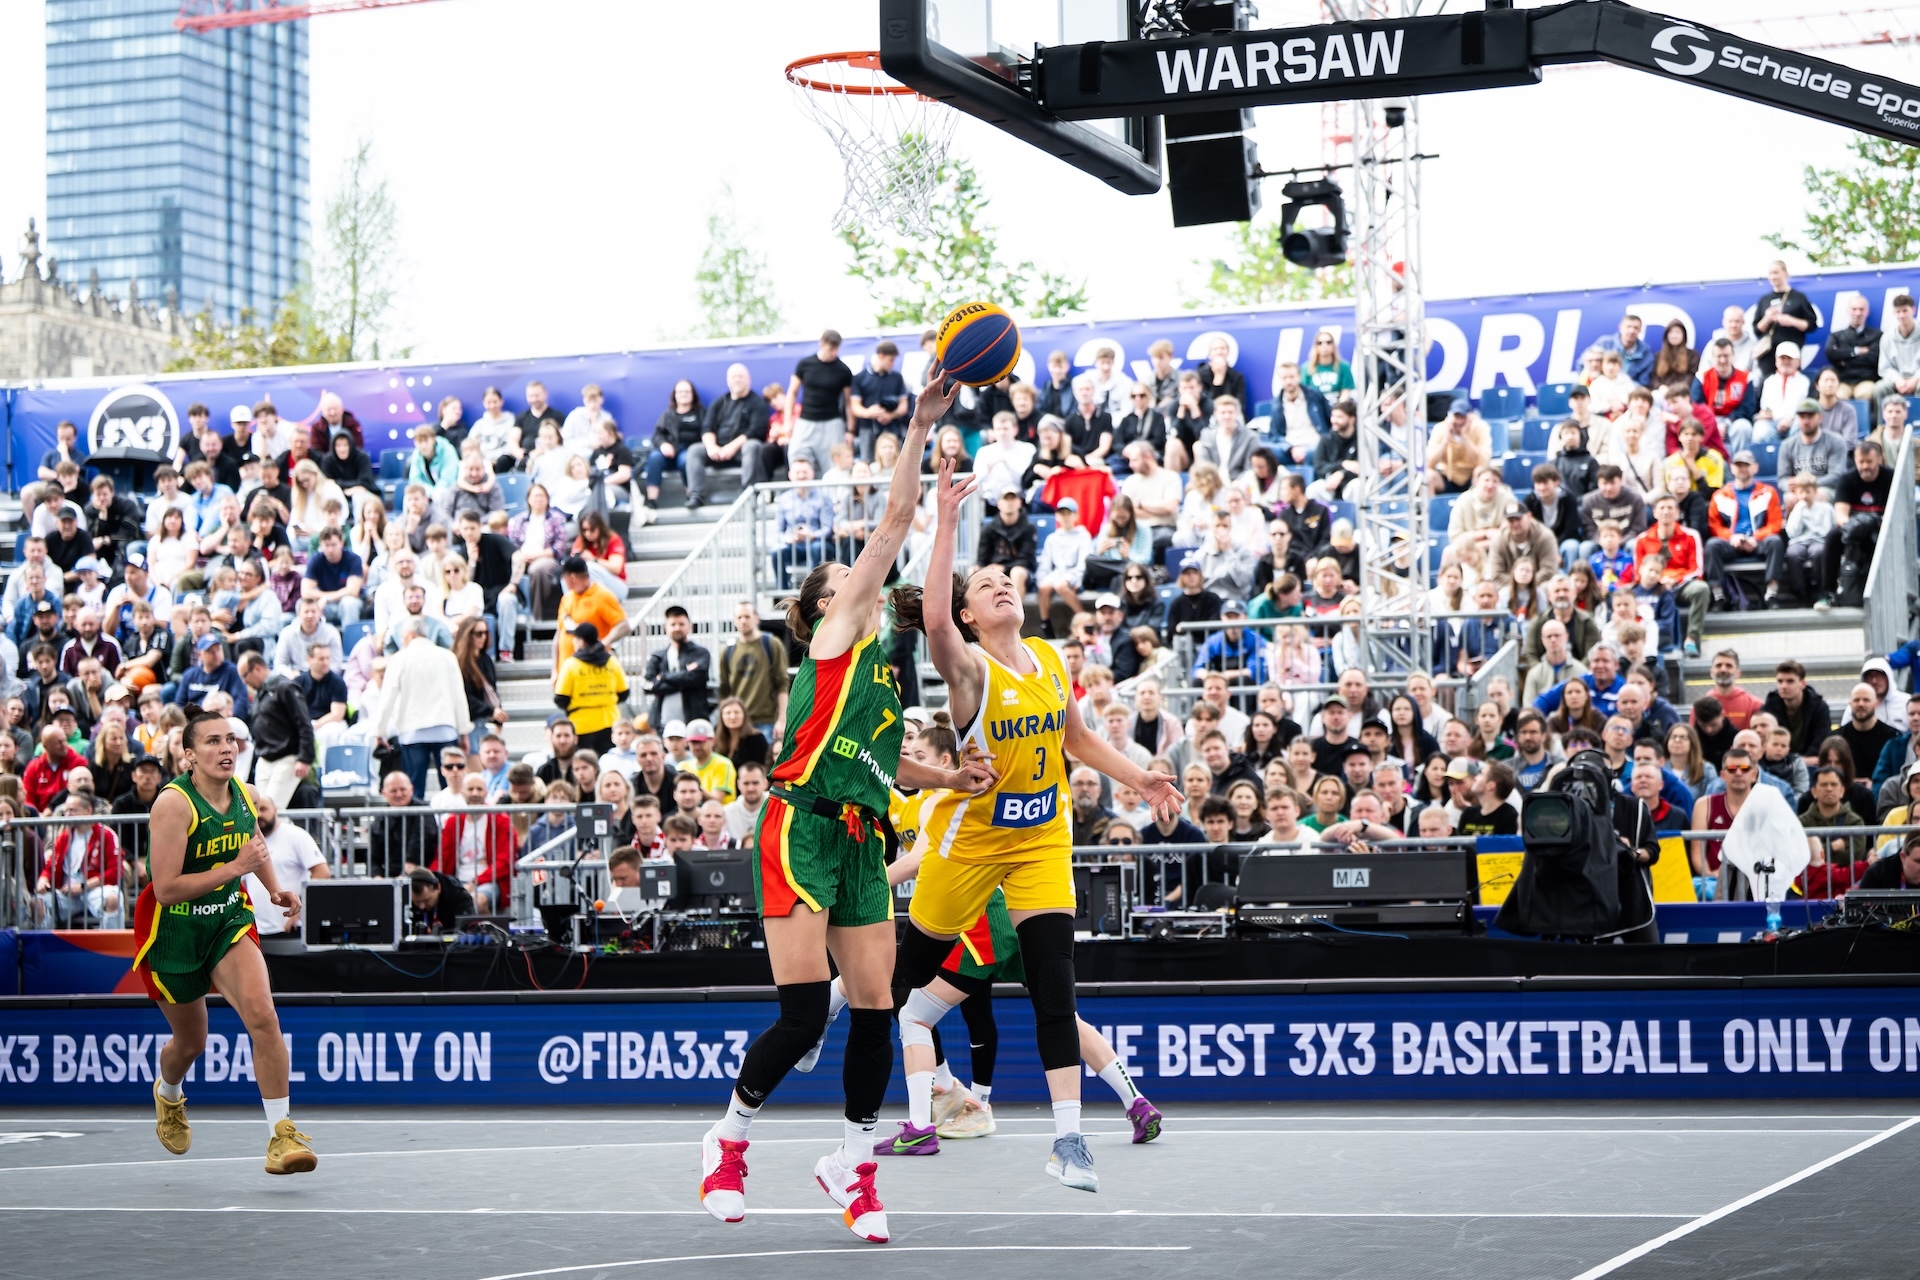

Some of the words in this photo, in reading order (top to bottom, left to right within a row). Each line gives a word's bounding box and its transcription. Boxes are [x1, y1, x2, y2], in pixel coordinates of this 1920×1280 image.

[1156, 29, 1404, 94] WARSAW
[1718, 45, 1852, 99] Schelde
[1882, 112, 1920, 131] Superior
[938, 303, 987, 341] Wilson
[872, 707, 897, 742] 7
[1032, 746, 1046, 781] 3
[1002, 791, 1053, 821] BGV
[52, 1033, 306, 1083] BASKBAL
[317, 1031, 422, 1082] ONLY
[434, 1030, 492, 1082] ON
[537, 1030, 749, 1085] @FIBA3x3
[1158, 1023, 1275, 1077] BEST
[1288, 1022, 1376, 1076] 3X3
[1392, 1019, 1709, 1075] BASKETBALL
[1722, 1017, 1853, 1074] ONLY
